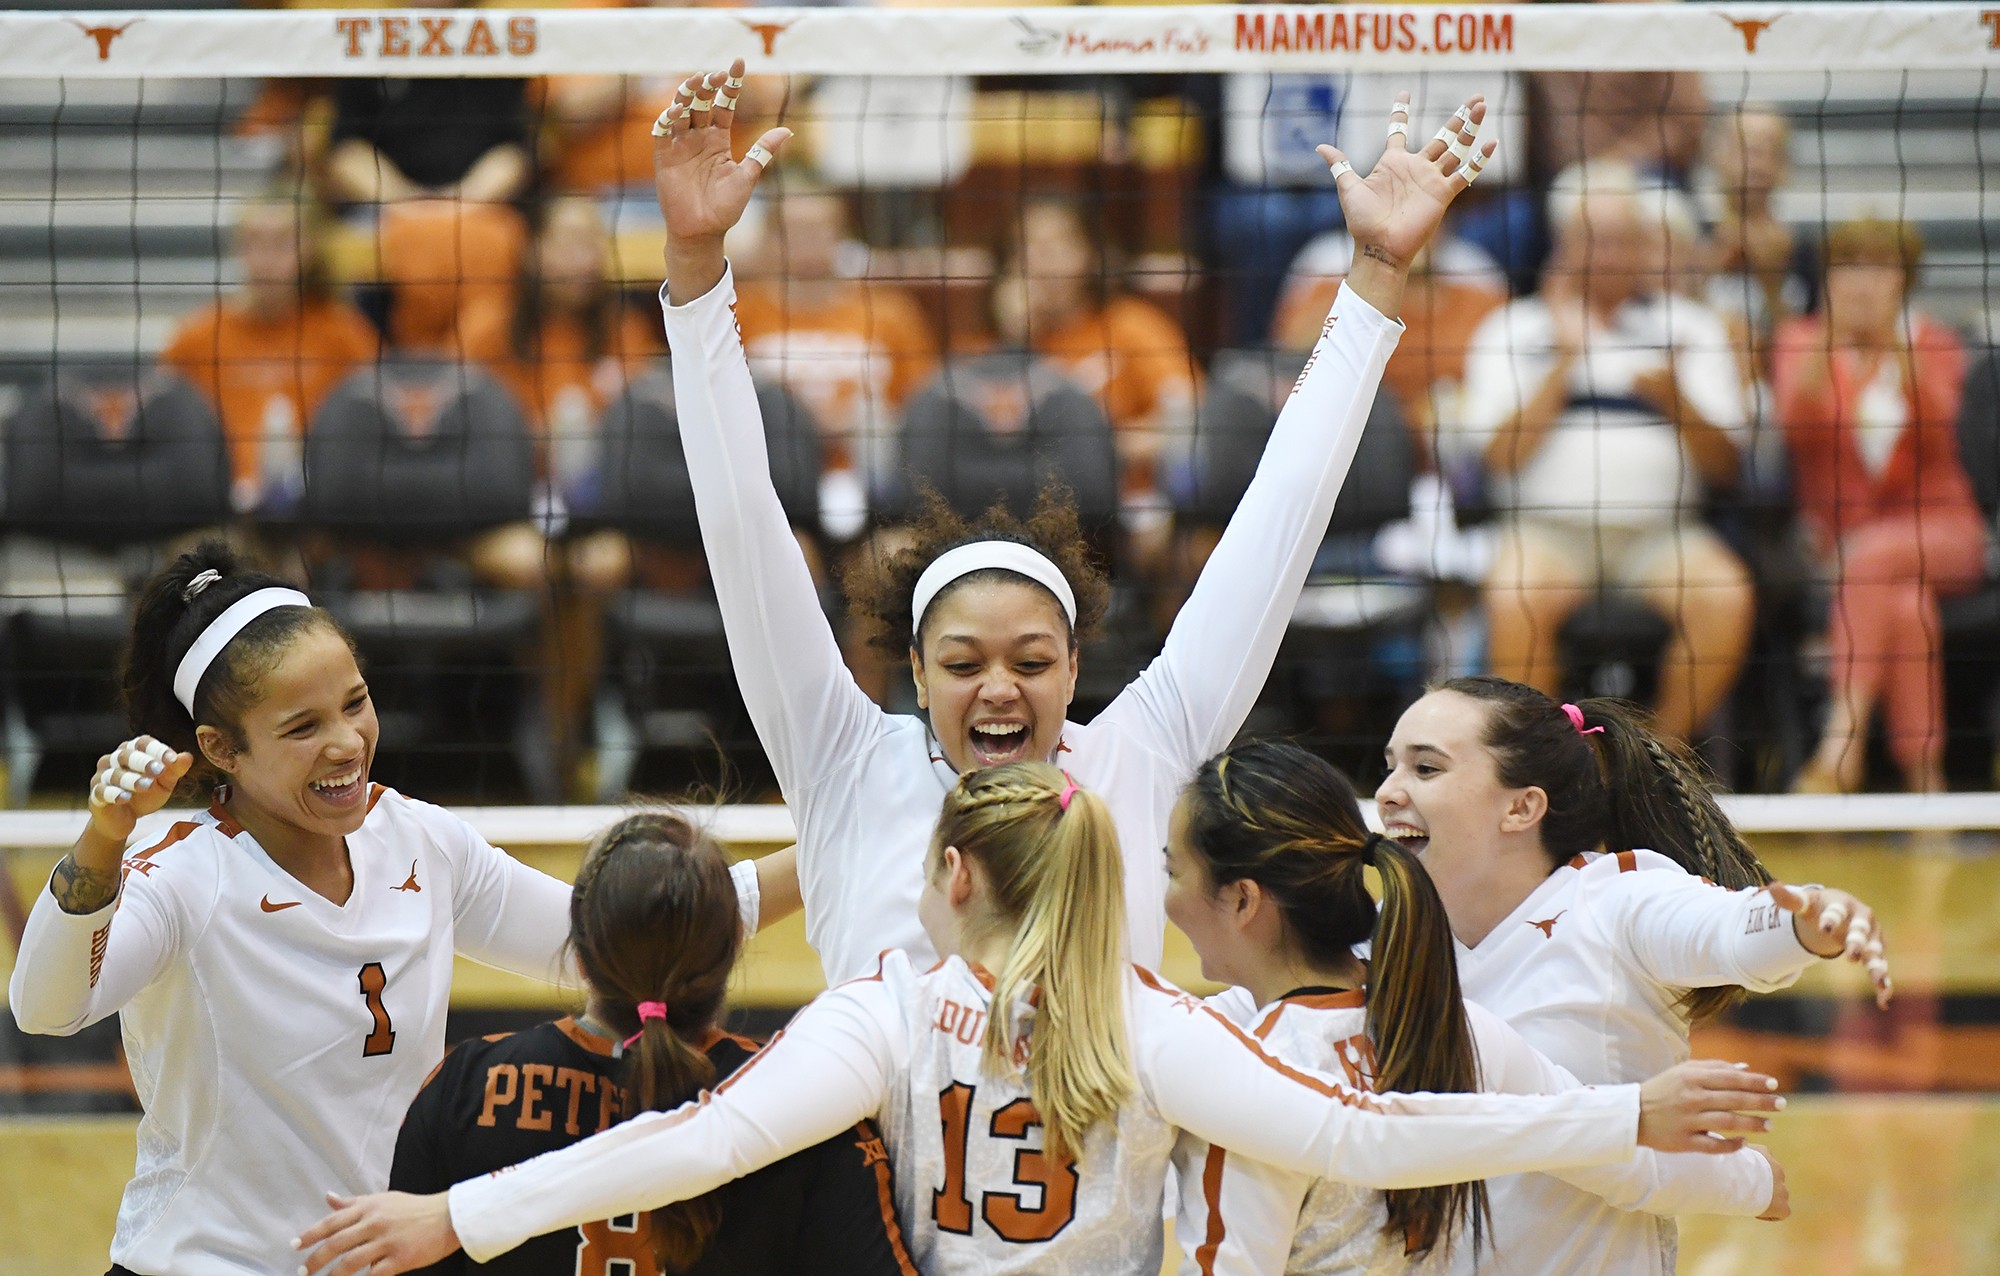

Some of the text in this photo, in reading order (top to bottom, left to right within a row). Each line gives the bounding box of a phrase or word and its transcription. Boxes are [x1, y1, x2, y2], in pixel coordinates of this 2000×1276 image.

[335, 16, 539, 57] TEXAS
[1234, 13, 1514, 52] MAMAFUS.COM
[357, 961, 397, 1058] 1
[931, 1079, 1080, 1244] 13
